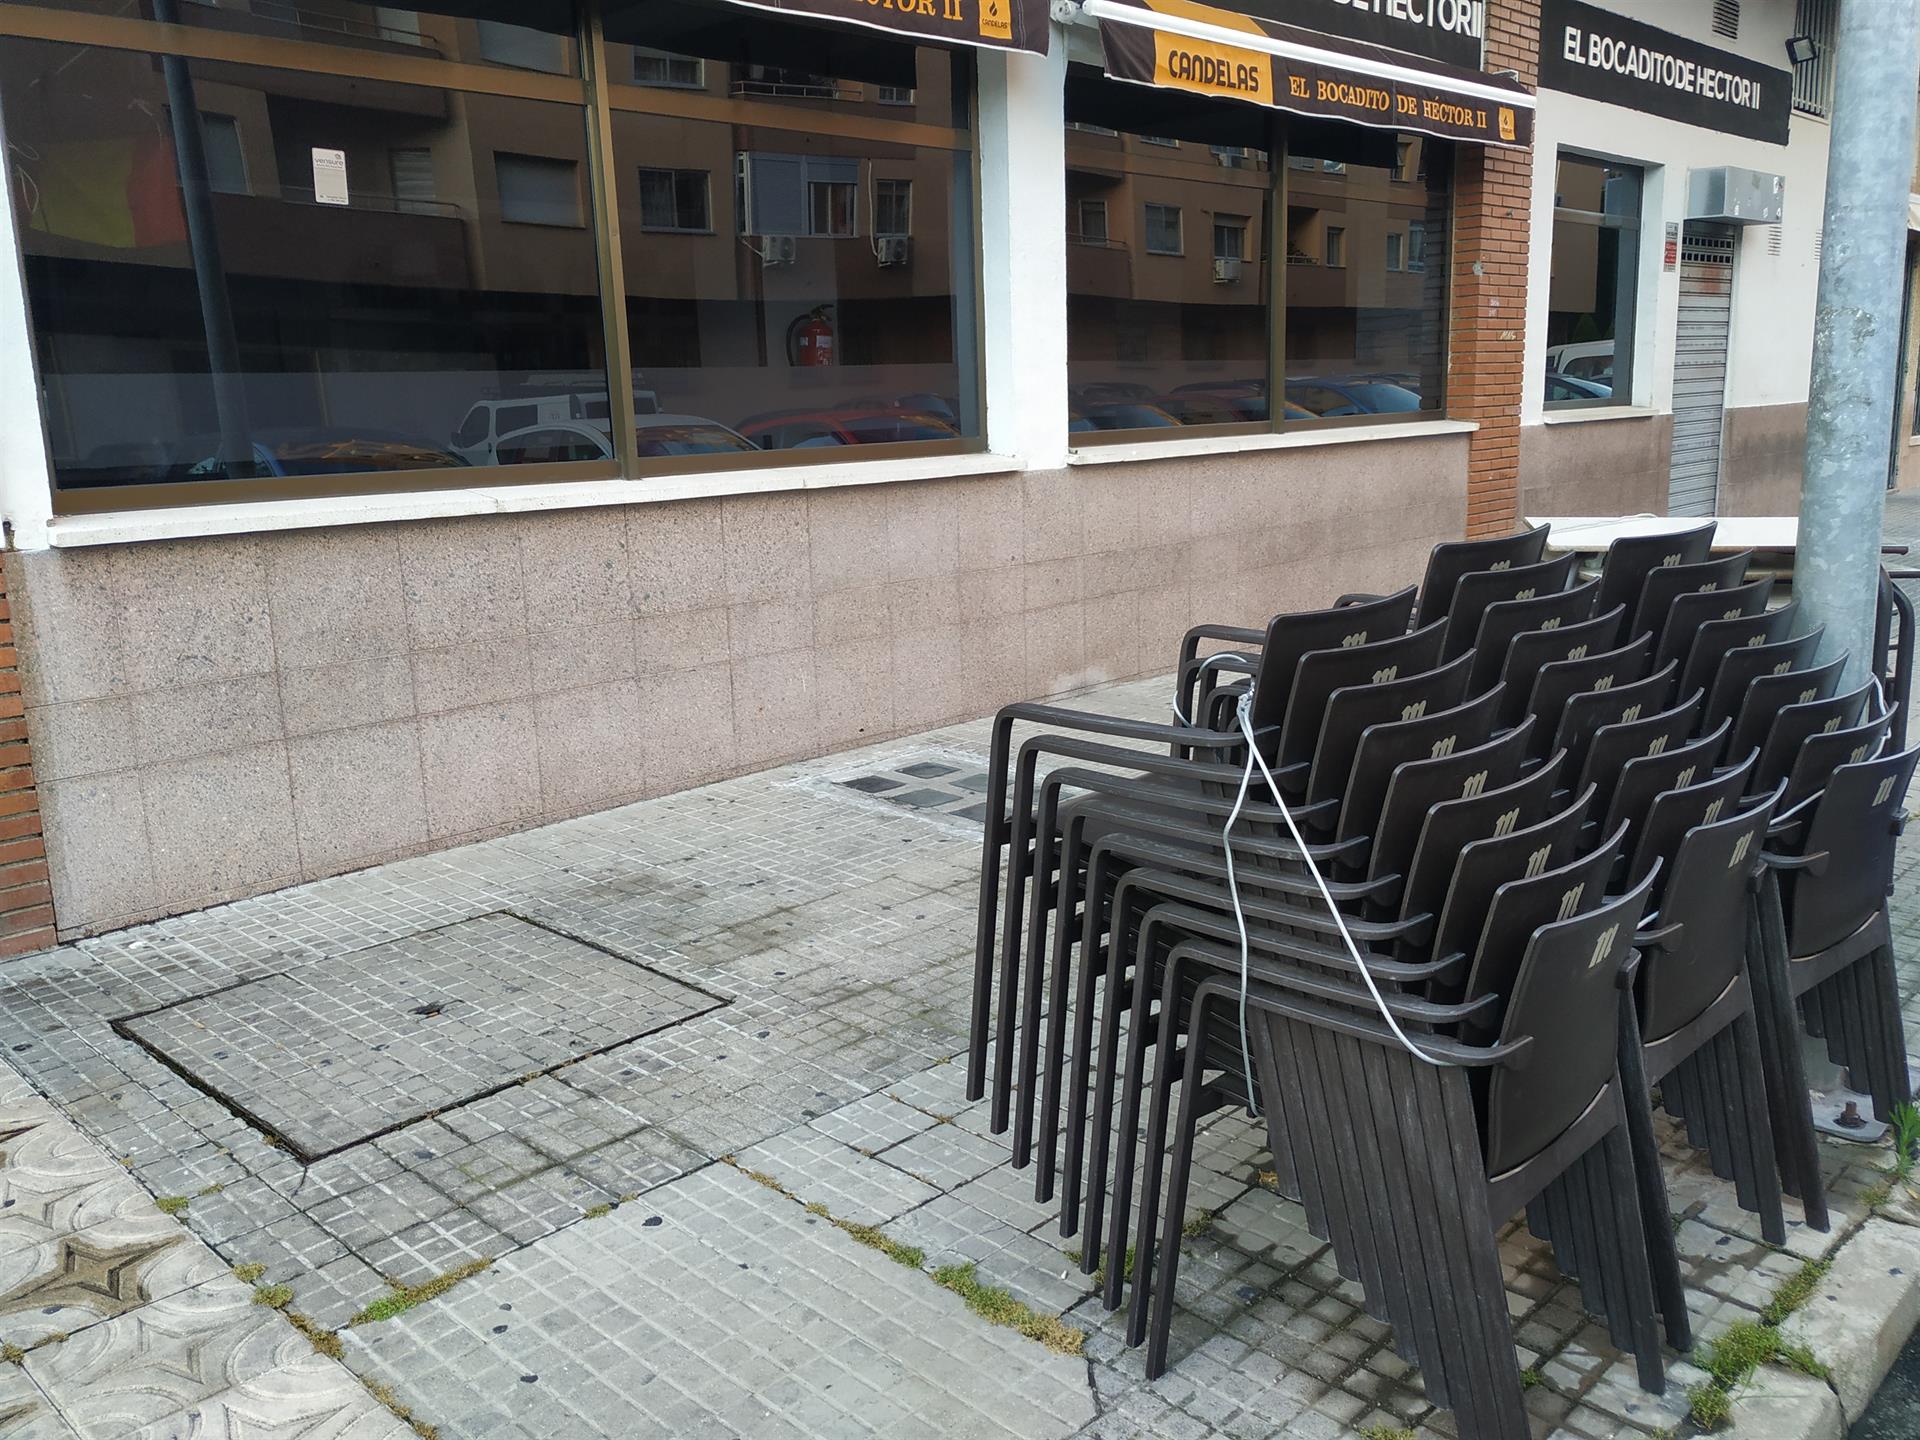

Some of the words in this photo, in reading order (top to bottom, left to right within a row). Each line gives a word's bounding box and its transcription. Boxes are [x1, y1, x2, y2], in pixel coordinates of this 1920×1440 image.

[1563, 26, 1587, 64] EL
[1168, 50, 1259, 92] CANDELAS
[1289, 76, 1310, 98] EL
[1317, 80, 1390, 112] BOCADITO
[1396, 94, 1417, 115] DE
[1476, 111, 1487, 129] II
